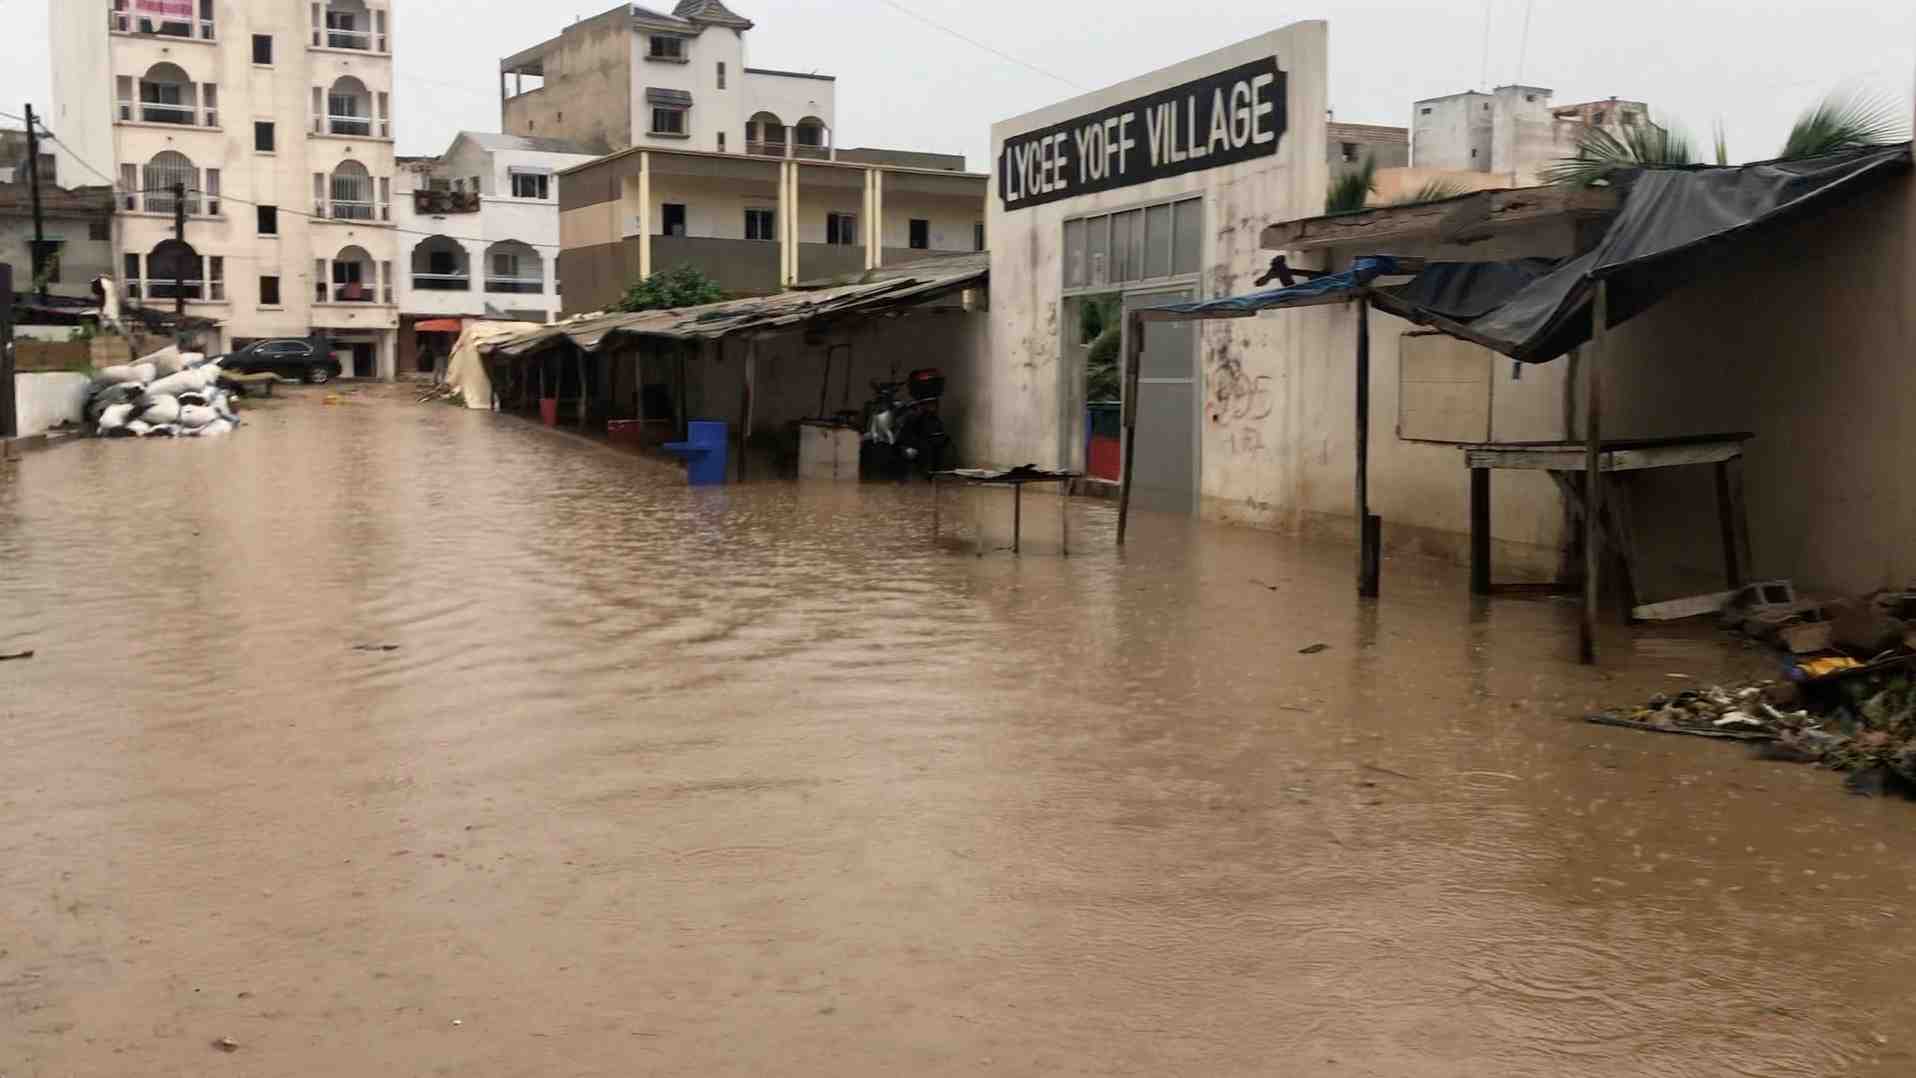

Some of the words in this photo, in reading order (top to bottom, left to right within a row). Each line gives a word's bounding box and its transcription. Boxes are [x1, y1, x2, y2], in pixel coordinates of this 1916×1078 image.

[1006, 132, 1067, 201] LYCEE
[1074, 112, 1135, 184] YOFF
[1146, 73, 1274, 167] VILLAGE
